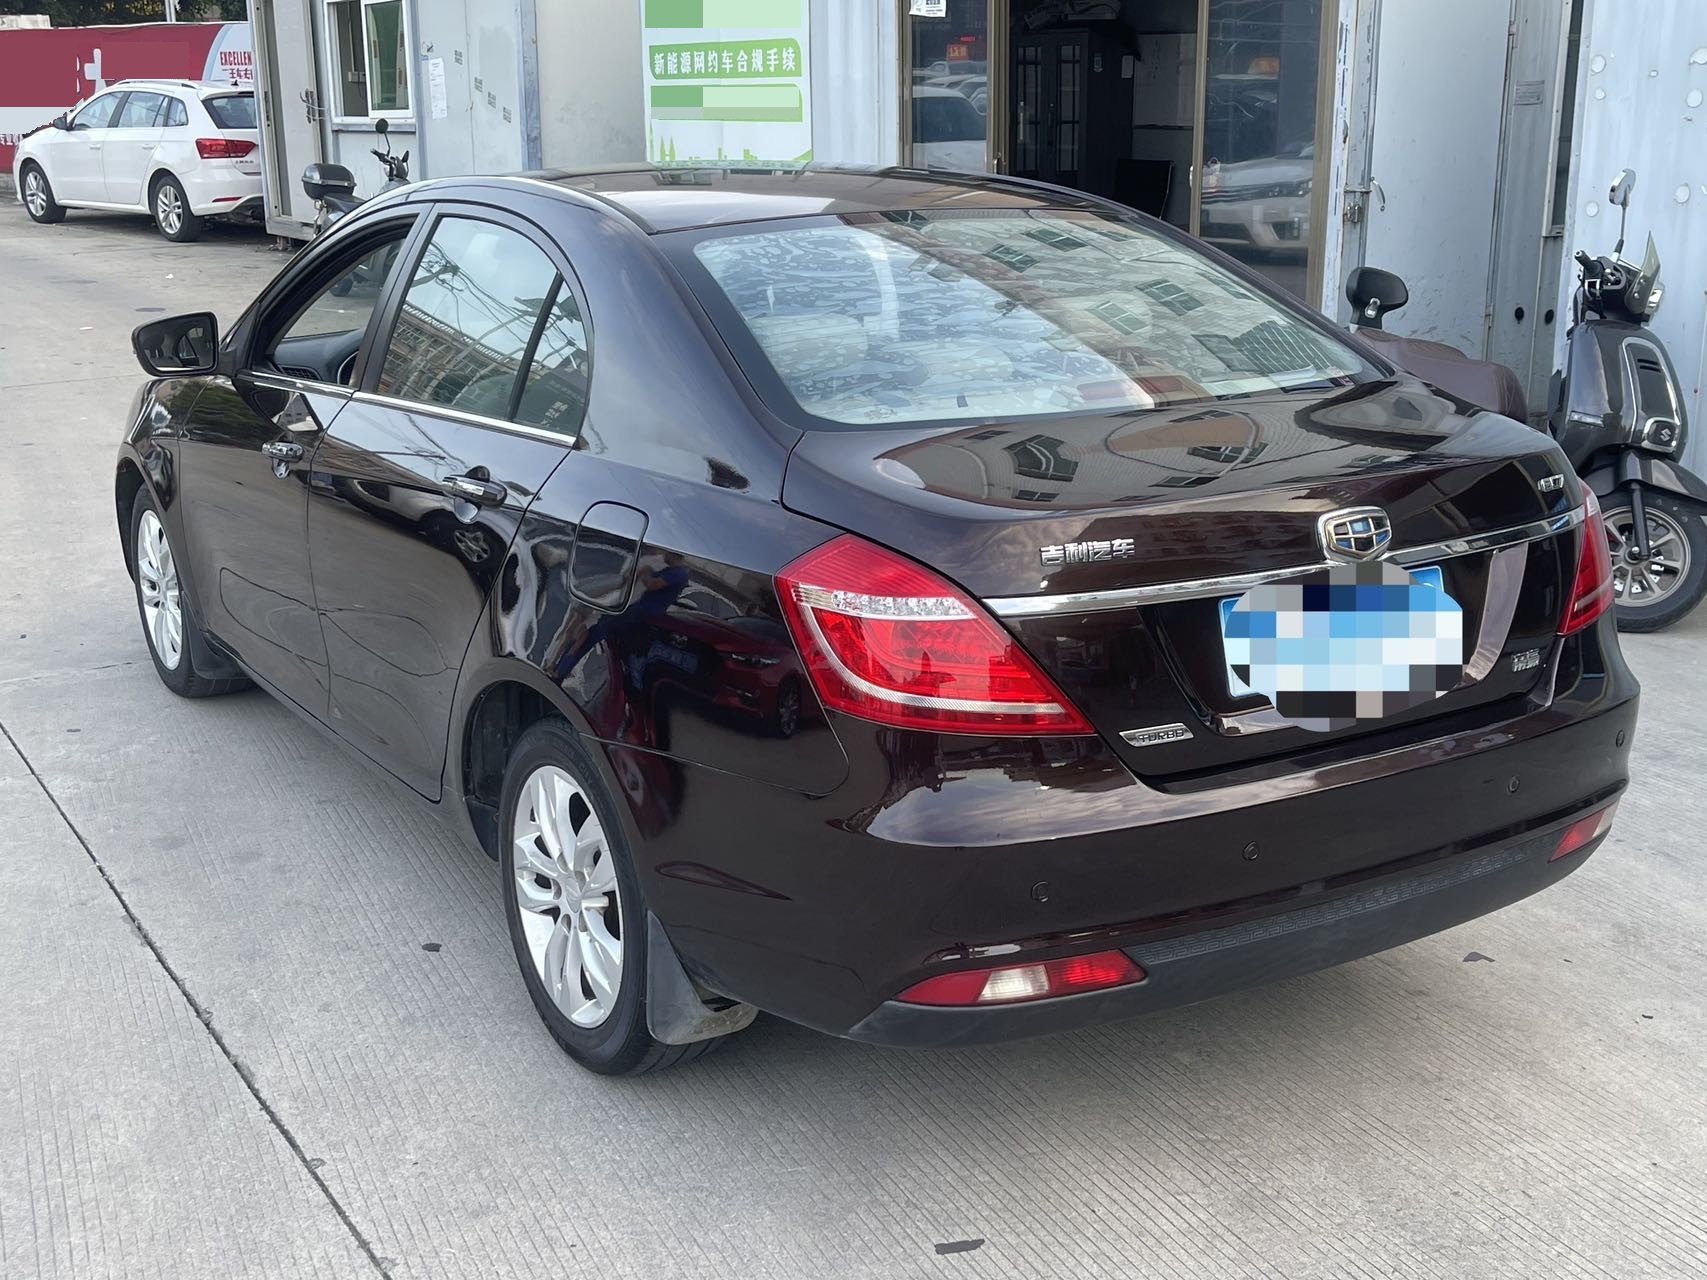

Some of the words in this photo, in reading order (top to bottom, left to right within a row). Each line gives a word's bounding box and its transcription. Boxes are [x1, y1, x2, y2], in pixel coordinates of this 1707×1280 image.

[653, 47, 797, 76] 新能源网约车合规手续
[1040, 538, 1135, 566] 吉利汽车
